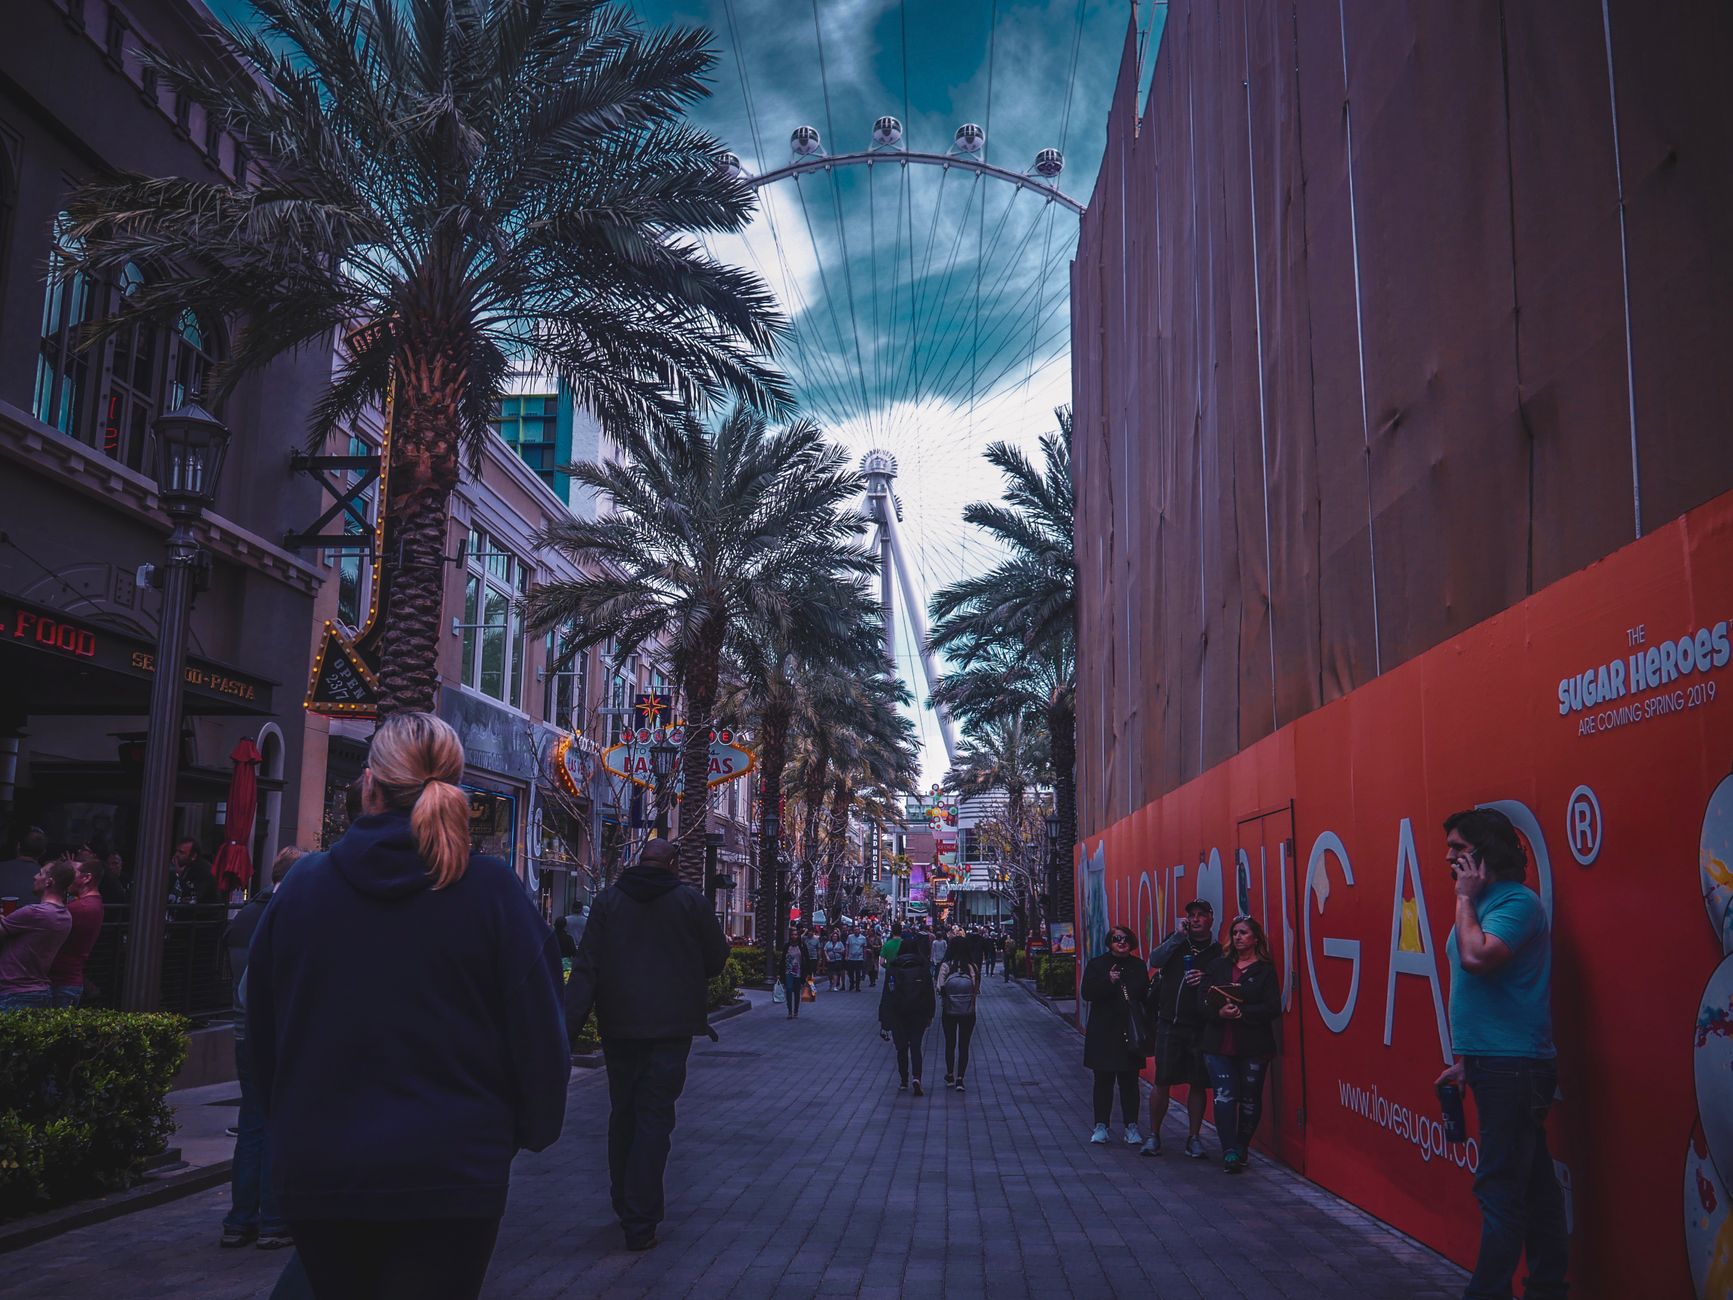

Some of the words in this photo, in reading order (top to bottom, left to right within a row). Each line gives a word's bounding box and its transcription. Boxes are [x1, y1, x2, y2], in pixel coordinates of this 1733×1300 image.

[14, 609, 96, 657] FOOD
[1627, 624, 1646, 647] THE
[131, 652, 255, 700] SEOD-PASTA
[334, 658, 367, 700] OPEN
[1558, 659, 1627, 716] SUGAR
[1577, 716, 1596, 737] ARE
[1597, 703, 1642, 731] COMING
[1644, 690, 1685, 719] SPRING
[1687, 681, 1716, 708] 2019
[1338, 1078, 1480, 1174] www.ilovesugar.co
